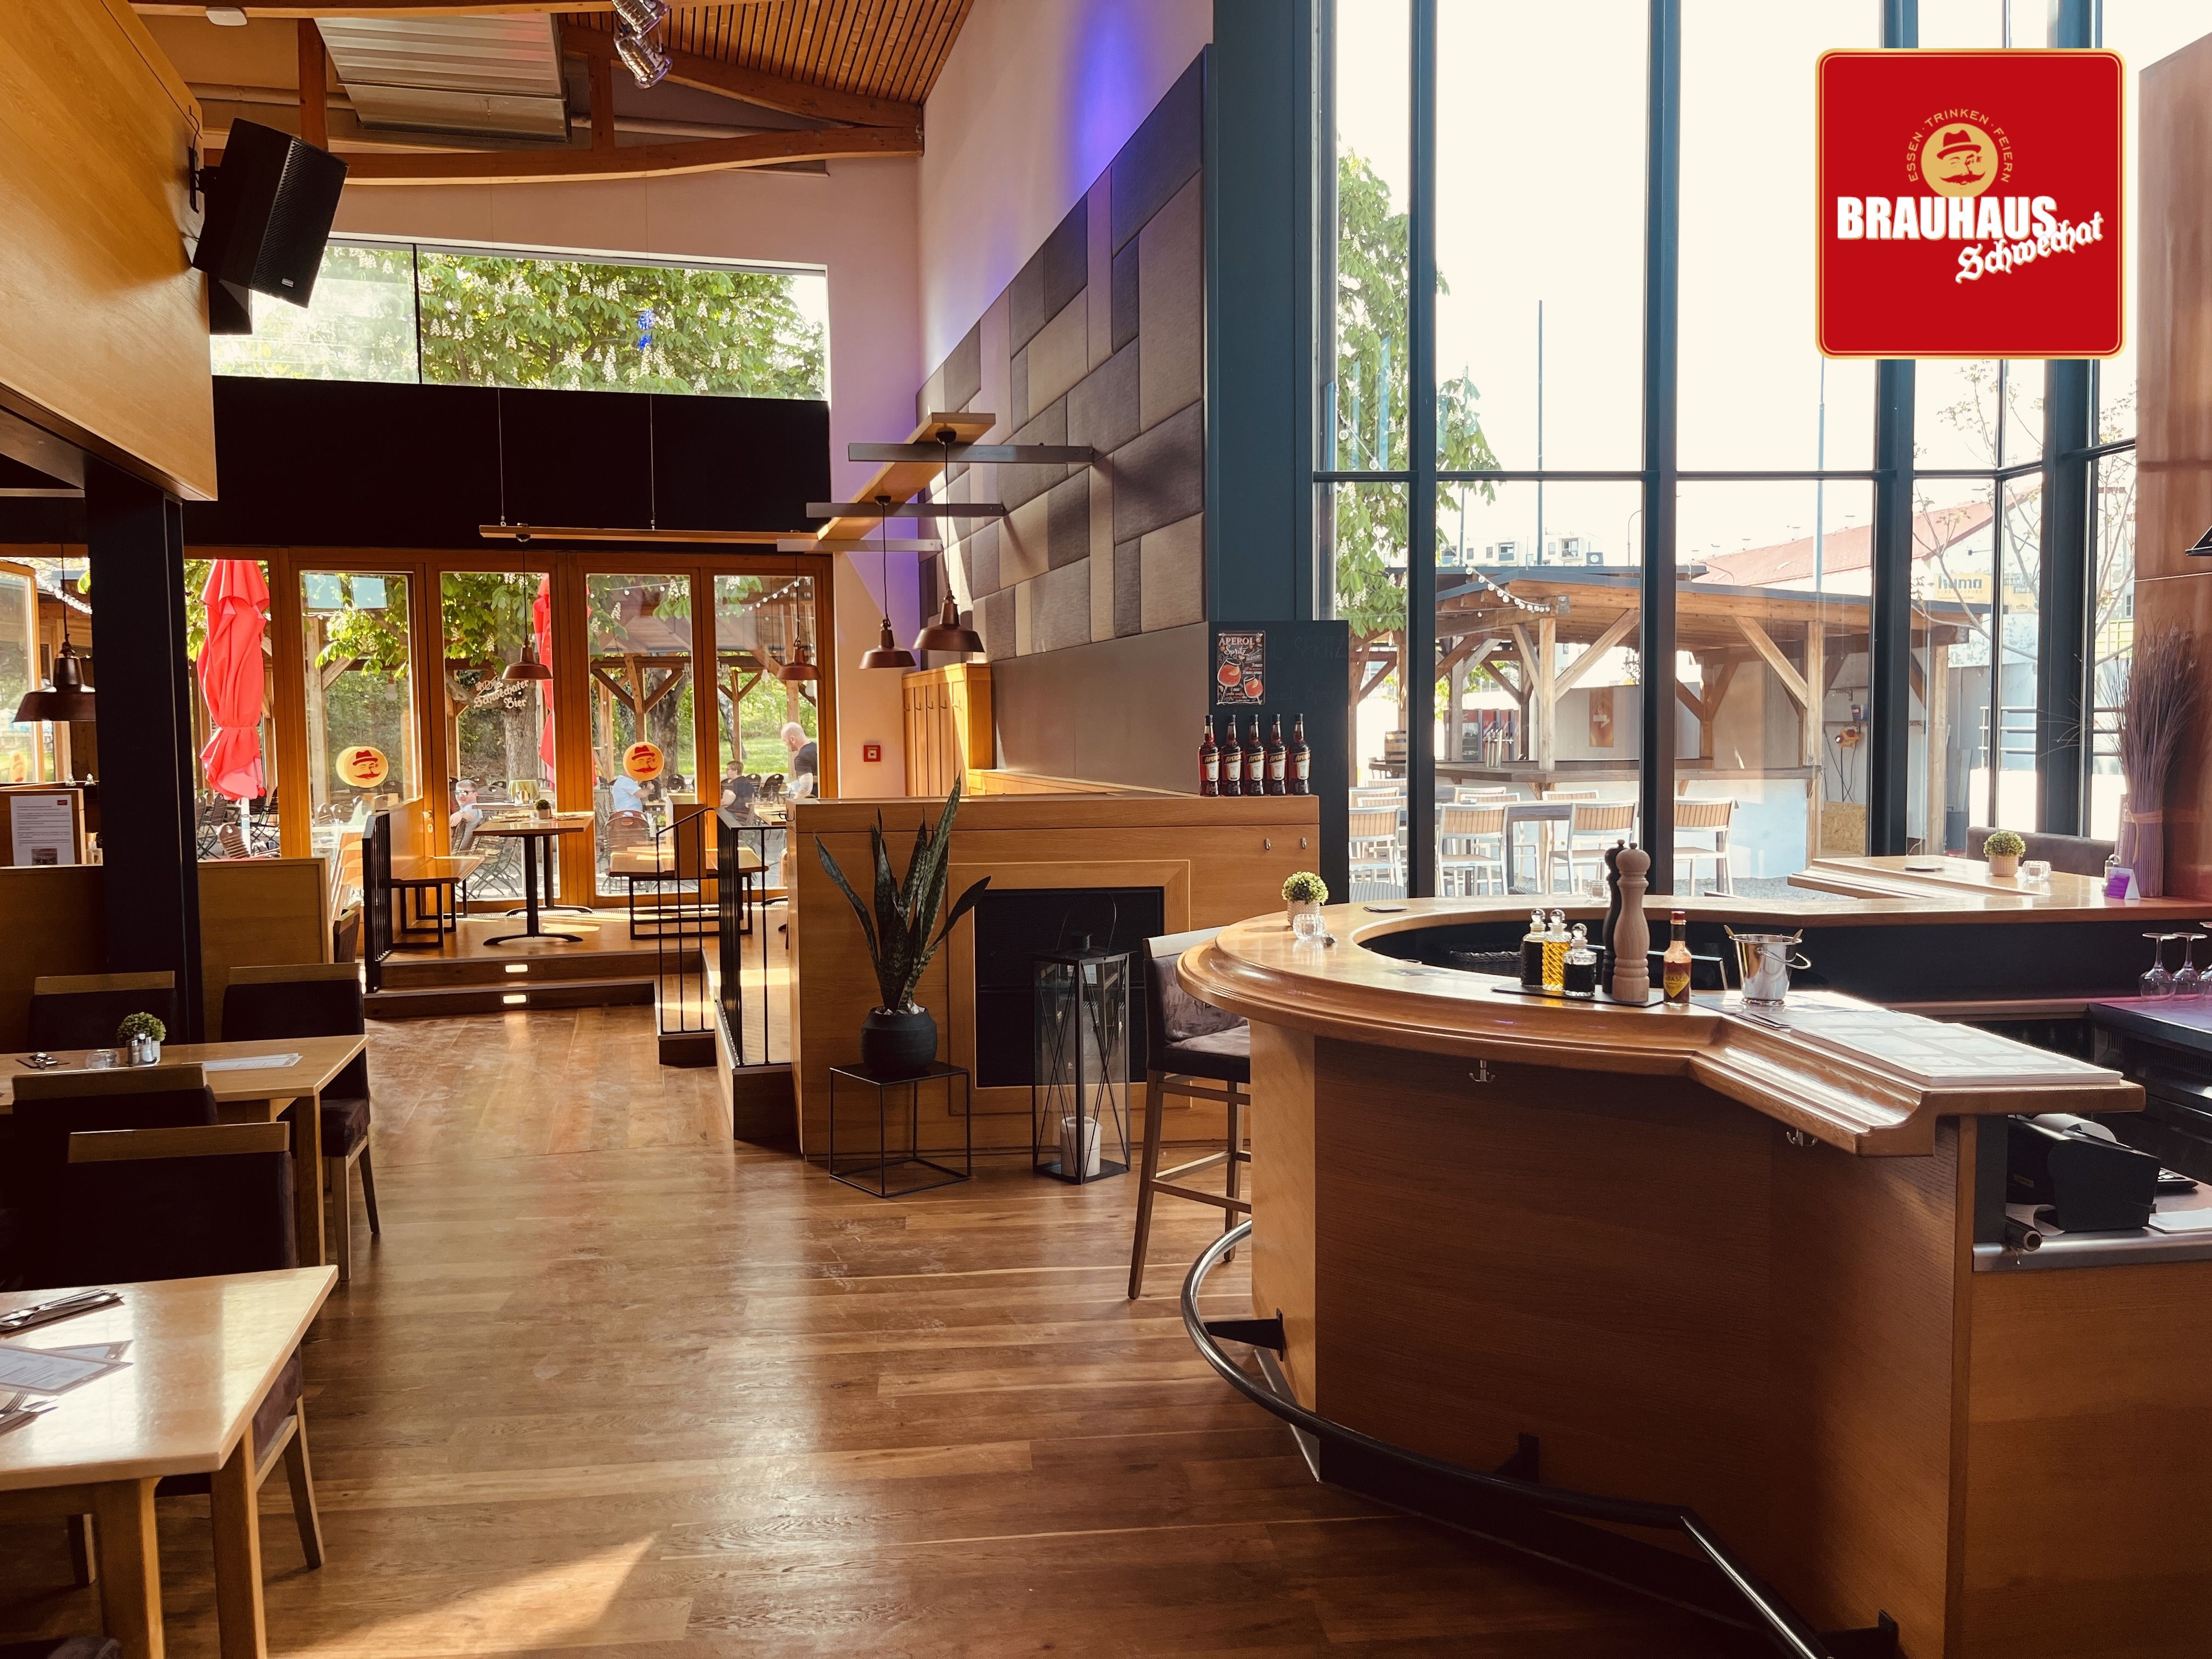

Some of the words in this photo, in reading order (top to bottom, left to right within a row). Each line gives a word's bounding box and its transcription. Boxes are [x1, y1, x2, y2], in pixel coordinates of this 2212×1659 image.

[1218, 637, 1255, 646] APEROL
[1224, 645, 1249, 657] Spritz
[503, 697, 527, 709] Bier
